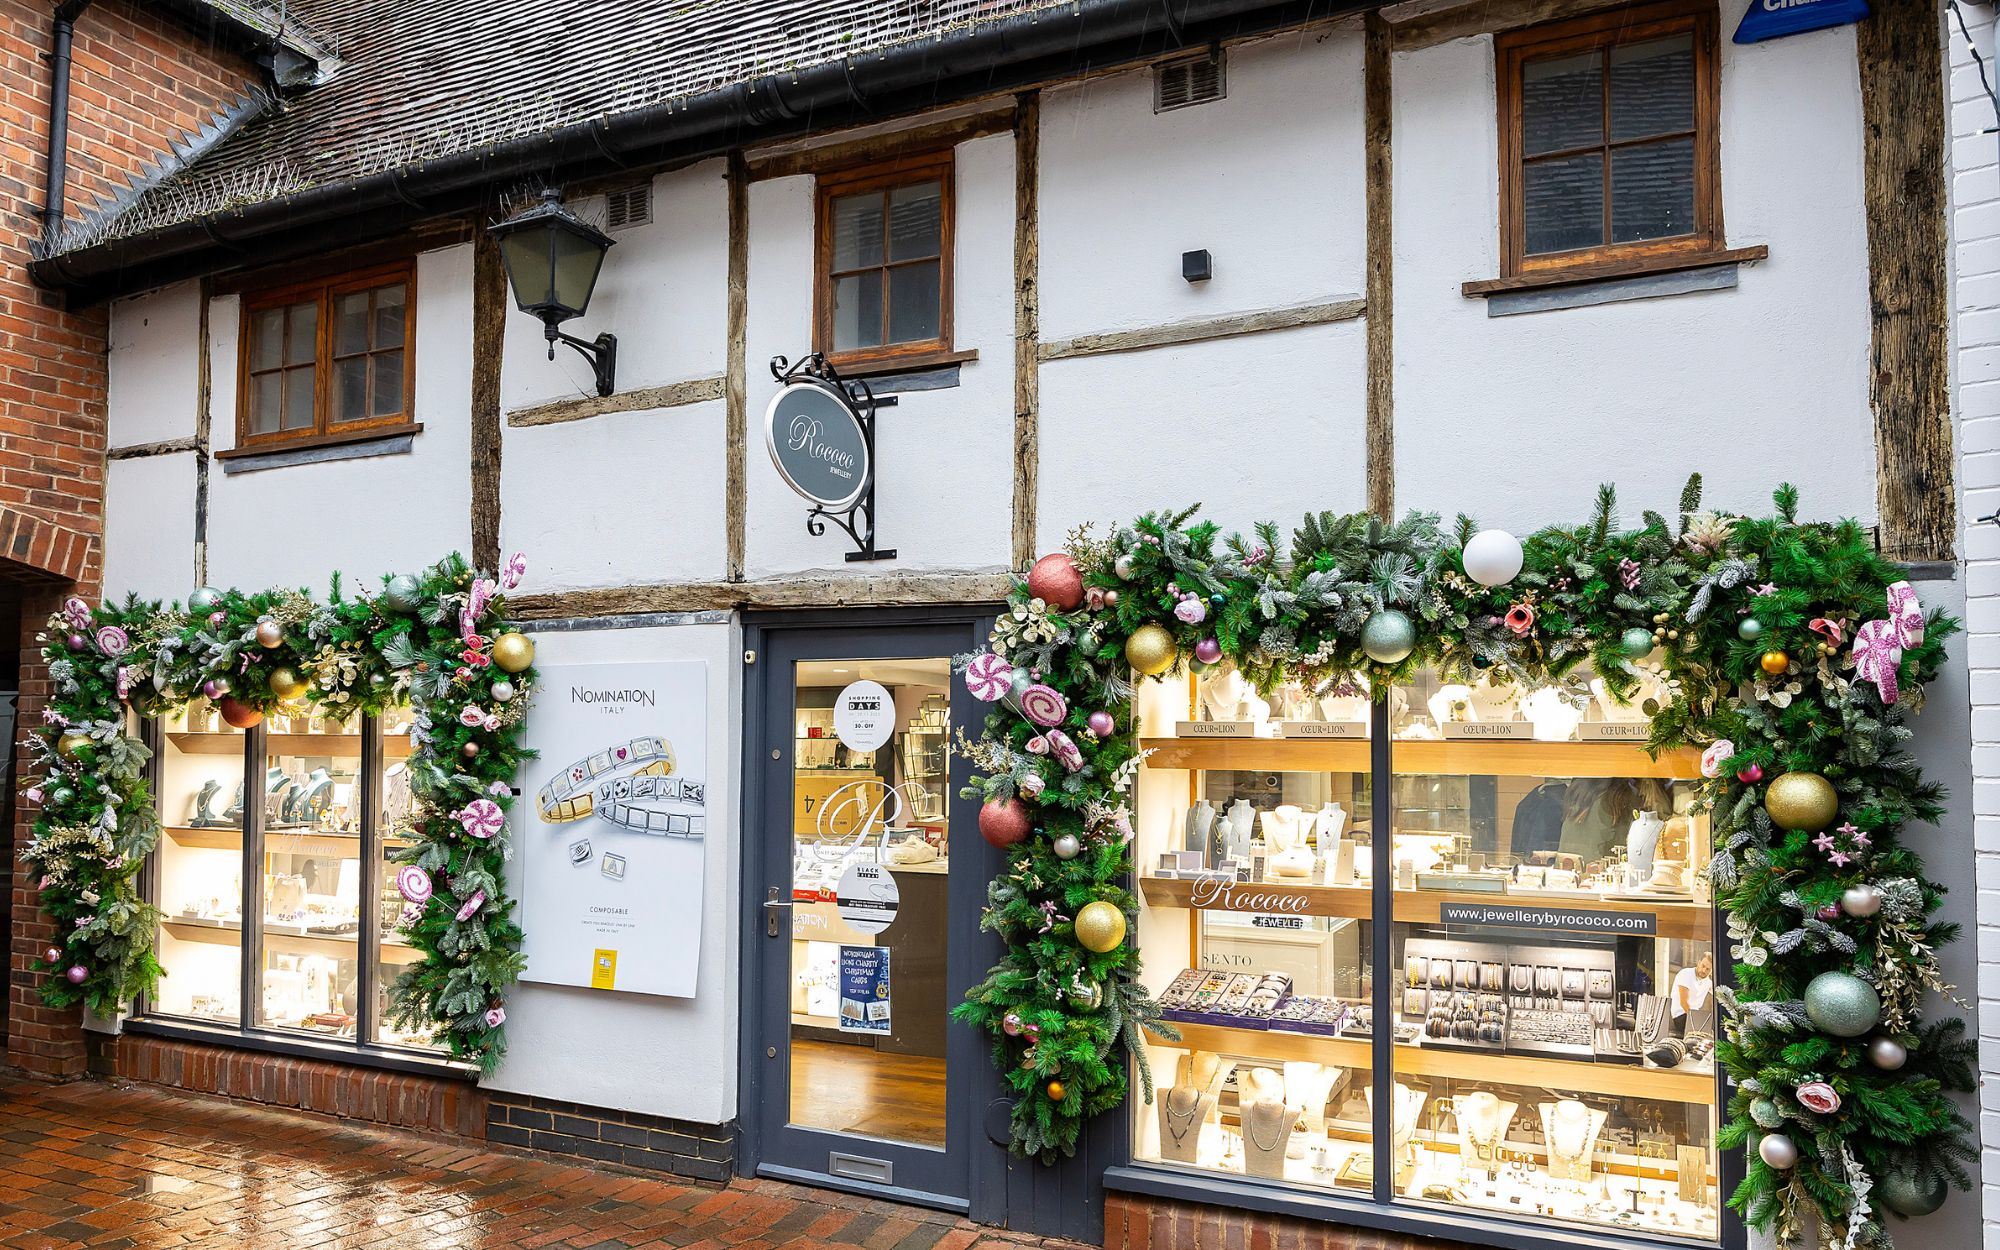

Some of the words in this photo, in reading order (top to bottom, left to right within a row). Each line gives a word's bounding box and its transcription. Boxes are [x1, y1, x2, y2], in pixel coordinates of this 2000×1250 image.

[788, 414, 855, 469] Rococo
[829, 466, 852, 480] JEWELLERY
[571, 686, 655, 708] NOMINATION
[600, 706, 625, 714] ITALY
[849, 702, 880, 710] DAYS
[1218, 724, 1236, 734] LION
[1327, 725, 1345, 734] LION
[1491, 725, 1512, 735] LION
[1632, 726, 1650, 736] LIO
[1190, 871, 1312, 912] Rococo
[589, 906, 629, 915] COMPOSABLE
[1447, 908, 1649, 930] www.jewellerybyrococo.com
[843, 950, 875, 959] WOKINGHAM
[855, 959, 879, 967] CHARITY
[844, 967, 875, 976] CHRISTMAS
